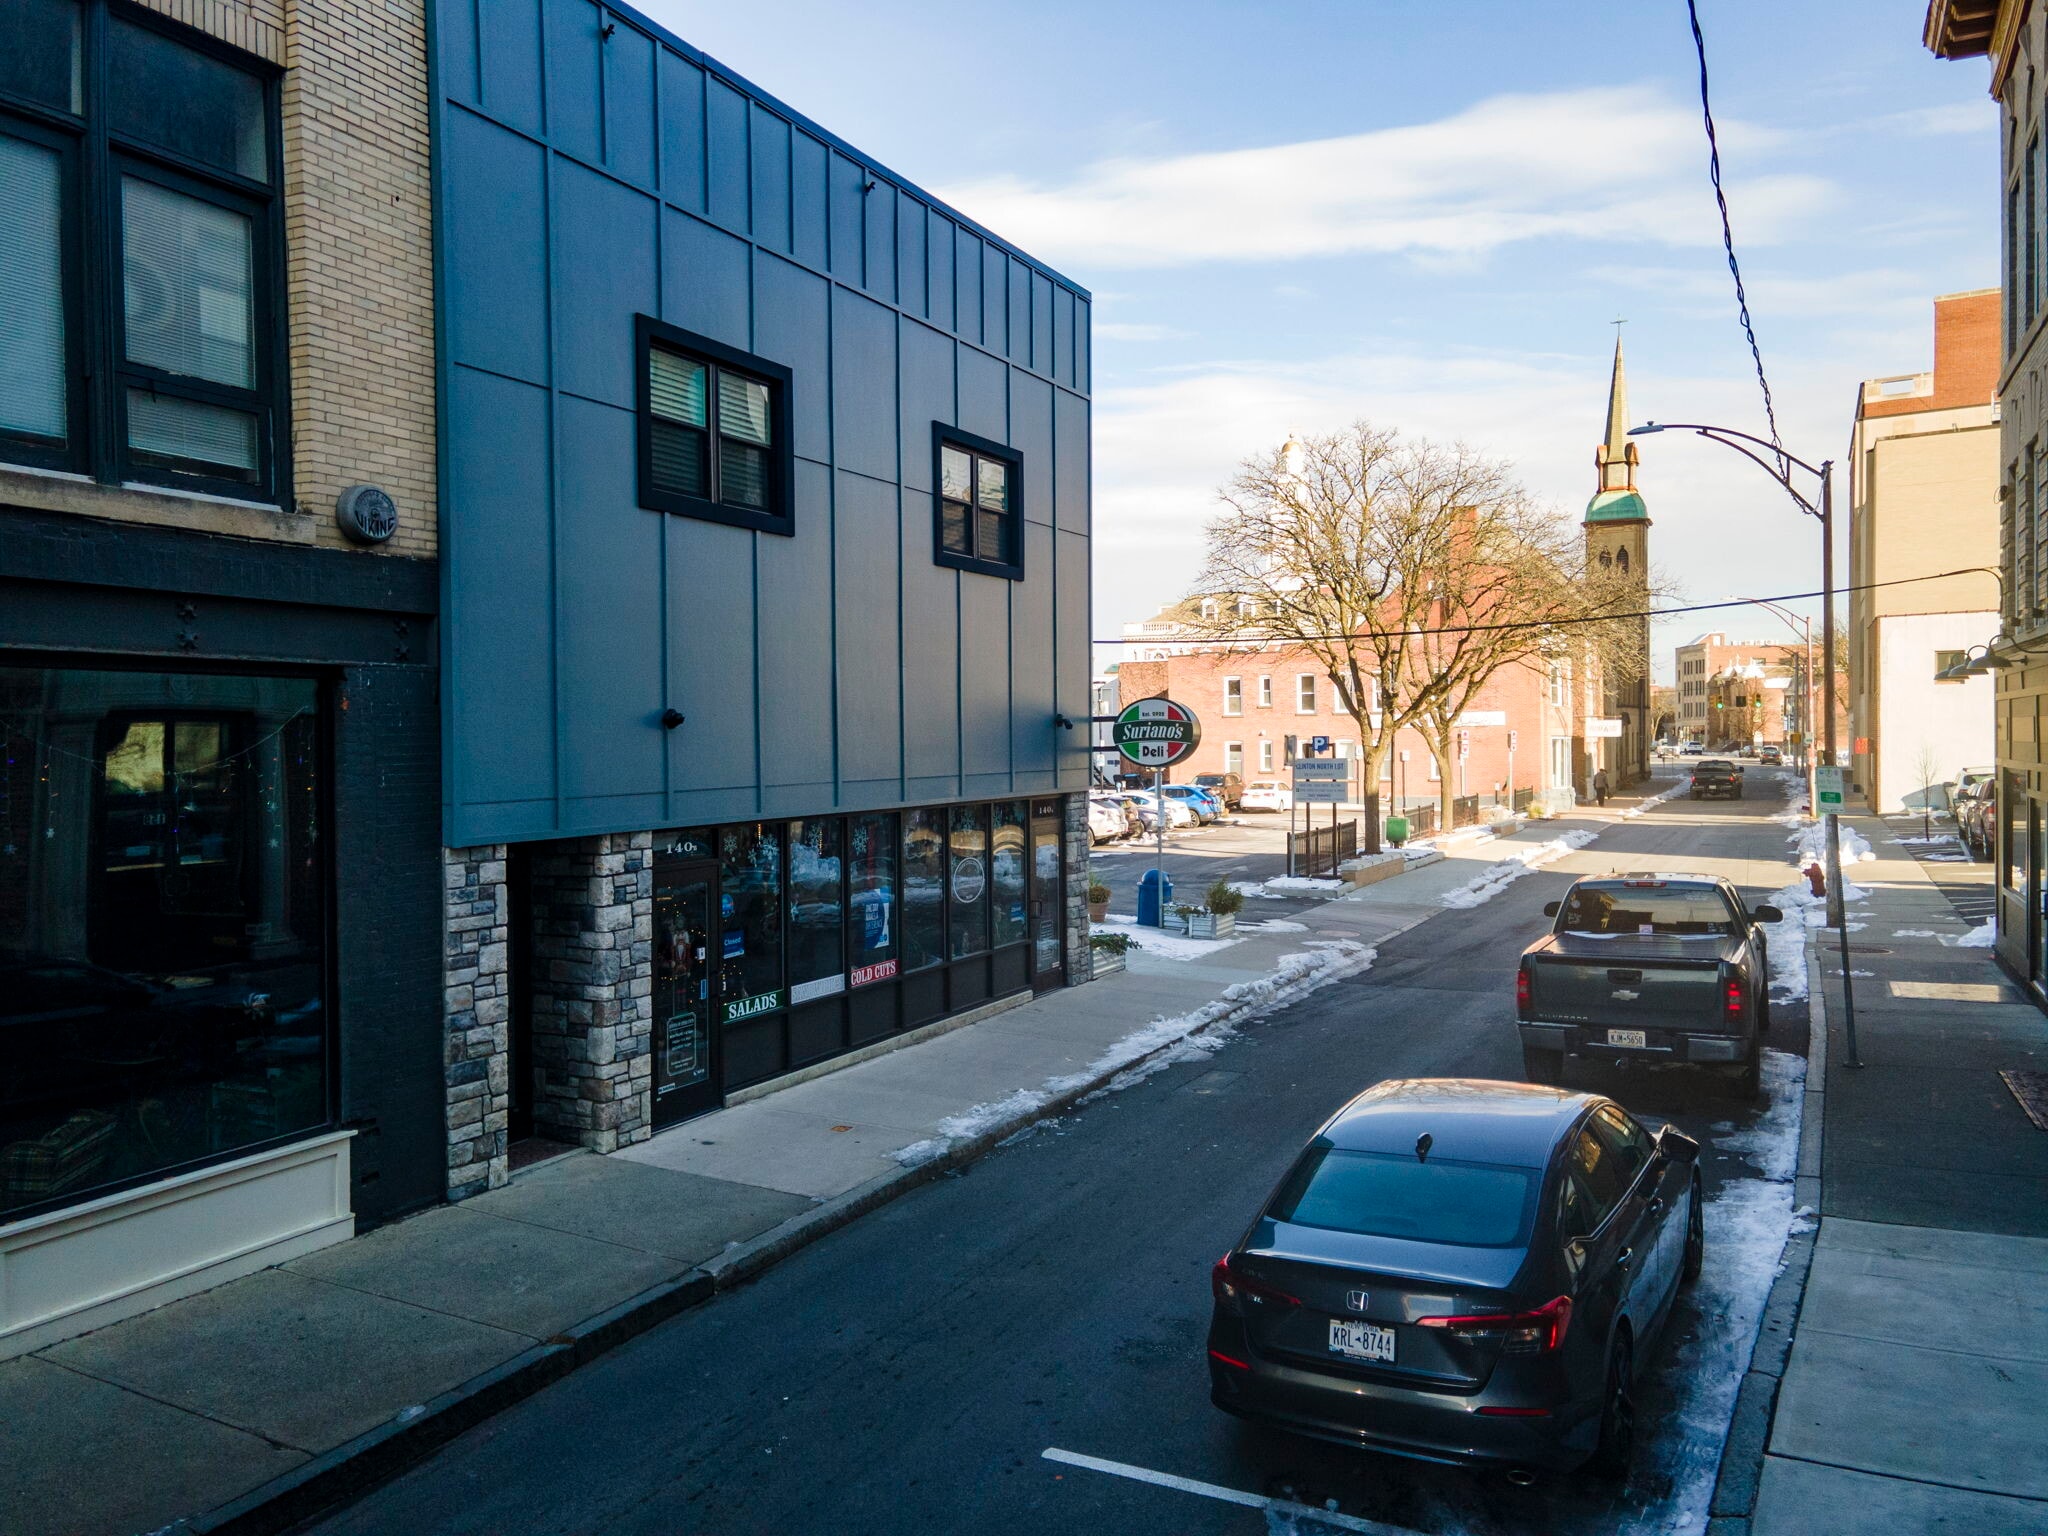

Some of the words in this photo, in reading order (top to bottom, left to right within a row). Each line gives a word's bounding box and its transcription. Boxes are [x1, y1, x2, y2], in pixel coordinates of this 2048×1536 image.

[354, 510, 394, 537] VIKING
[1122, 721, 1184, 740] Suriano's
[1314, 737, 1325, 750] P
[1142, 745, 1164, 758] Deli
[851, 968, 873, 986] COLD
[874, 960, 897, 980] CUTS
[728, 993, 777, 1019] SALADS
[1333, 1326, 1354, 1348] KRL
[1362, 1332, 1391, 1354] 8744
